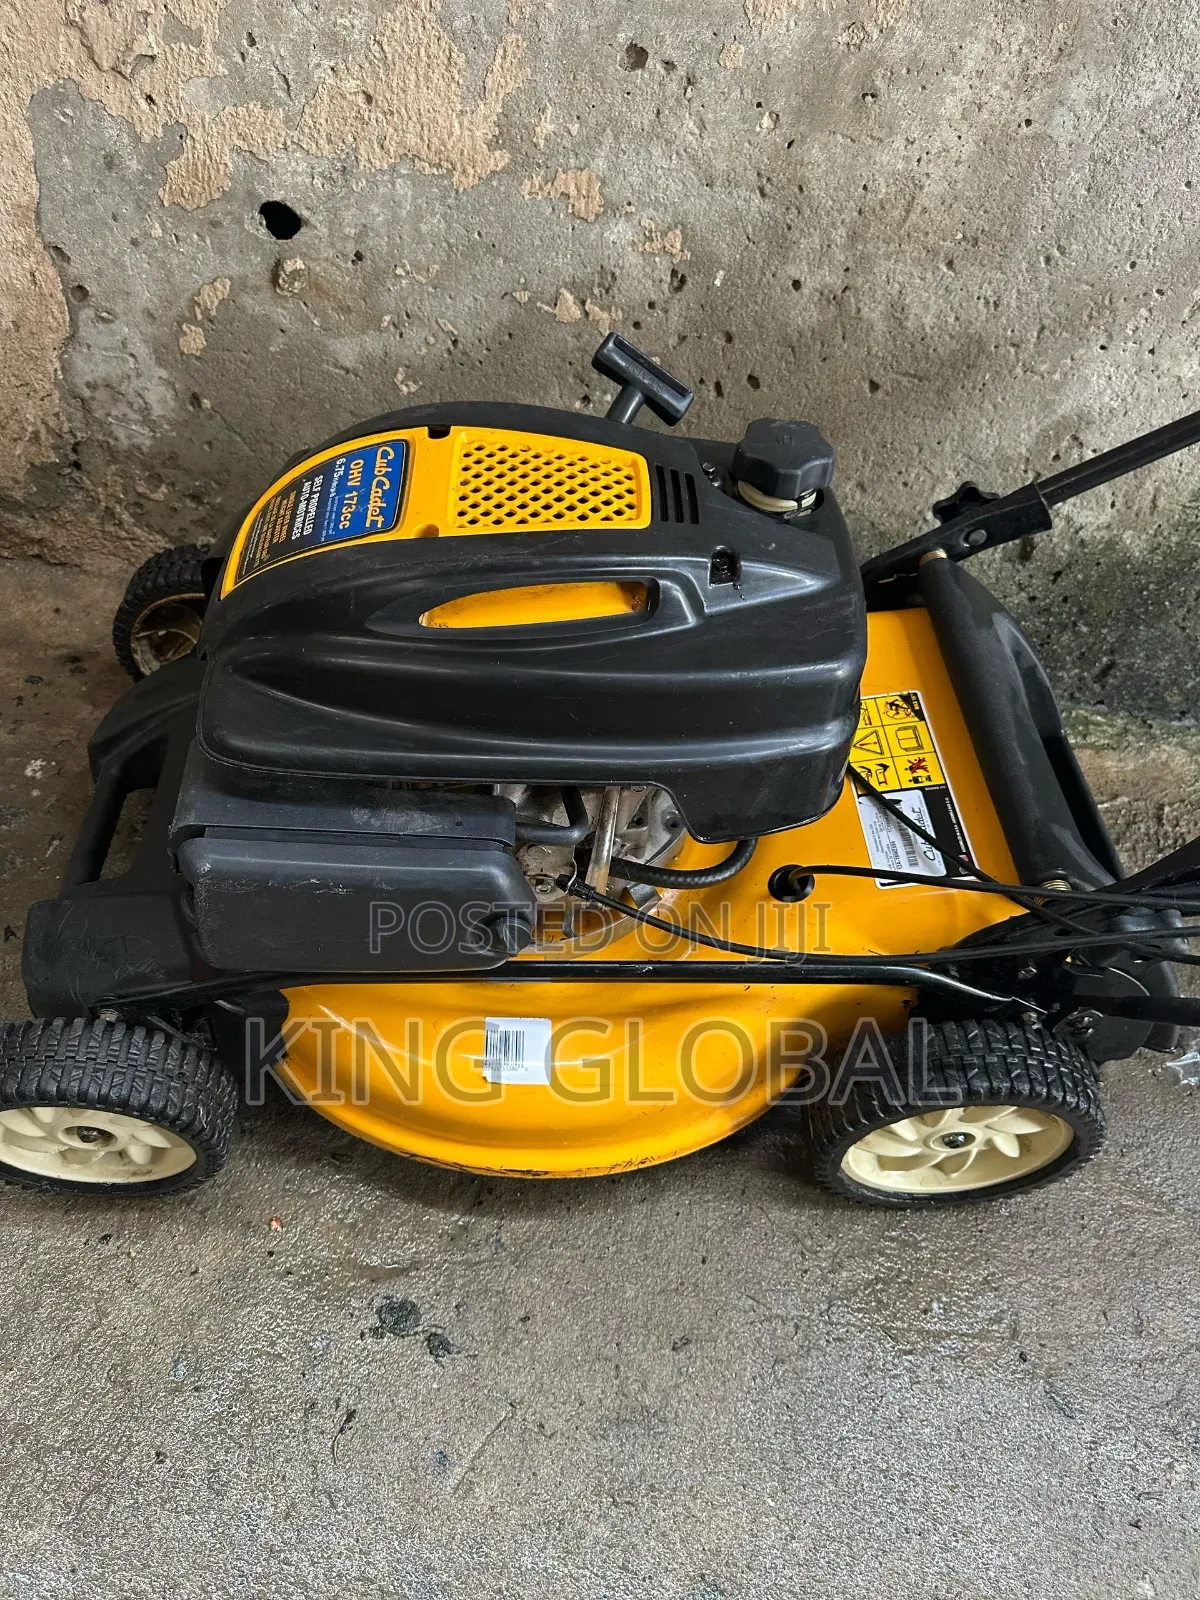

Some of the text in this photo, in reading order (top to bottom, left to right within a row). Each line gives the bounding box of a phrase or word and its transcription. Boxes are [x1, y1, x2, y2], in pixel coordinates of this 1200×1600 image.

[624, 361, 665, 394] START
[292, 481, 312, 540] AUTO-MOTRICES
[303, 475, 324, 535] SELF PROPELLED
[339, 459, 364, 529] OHV 173cc
[365, 446, 395, 528] Cub Cadet
